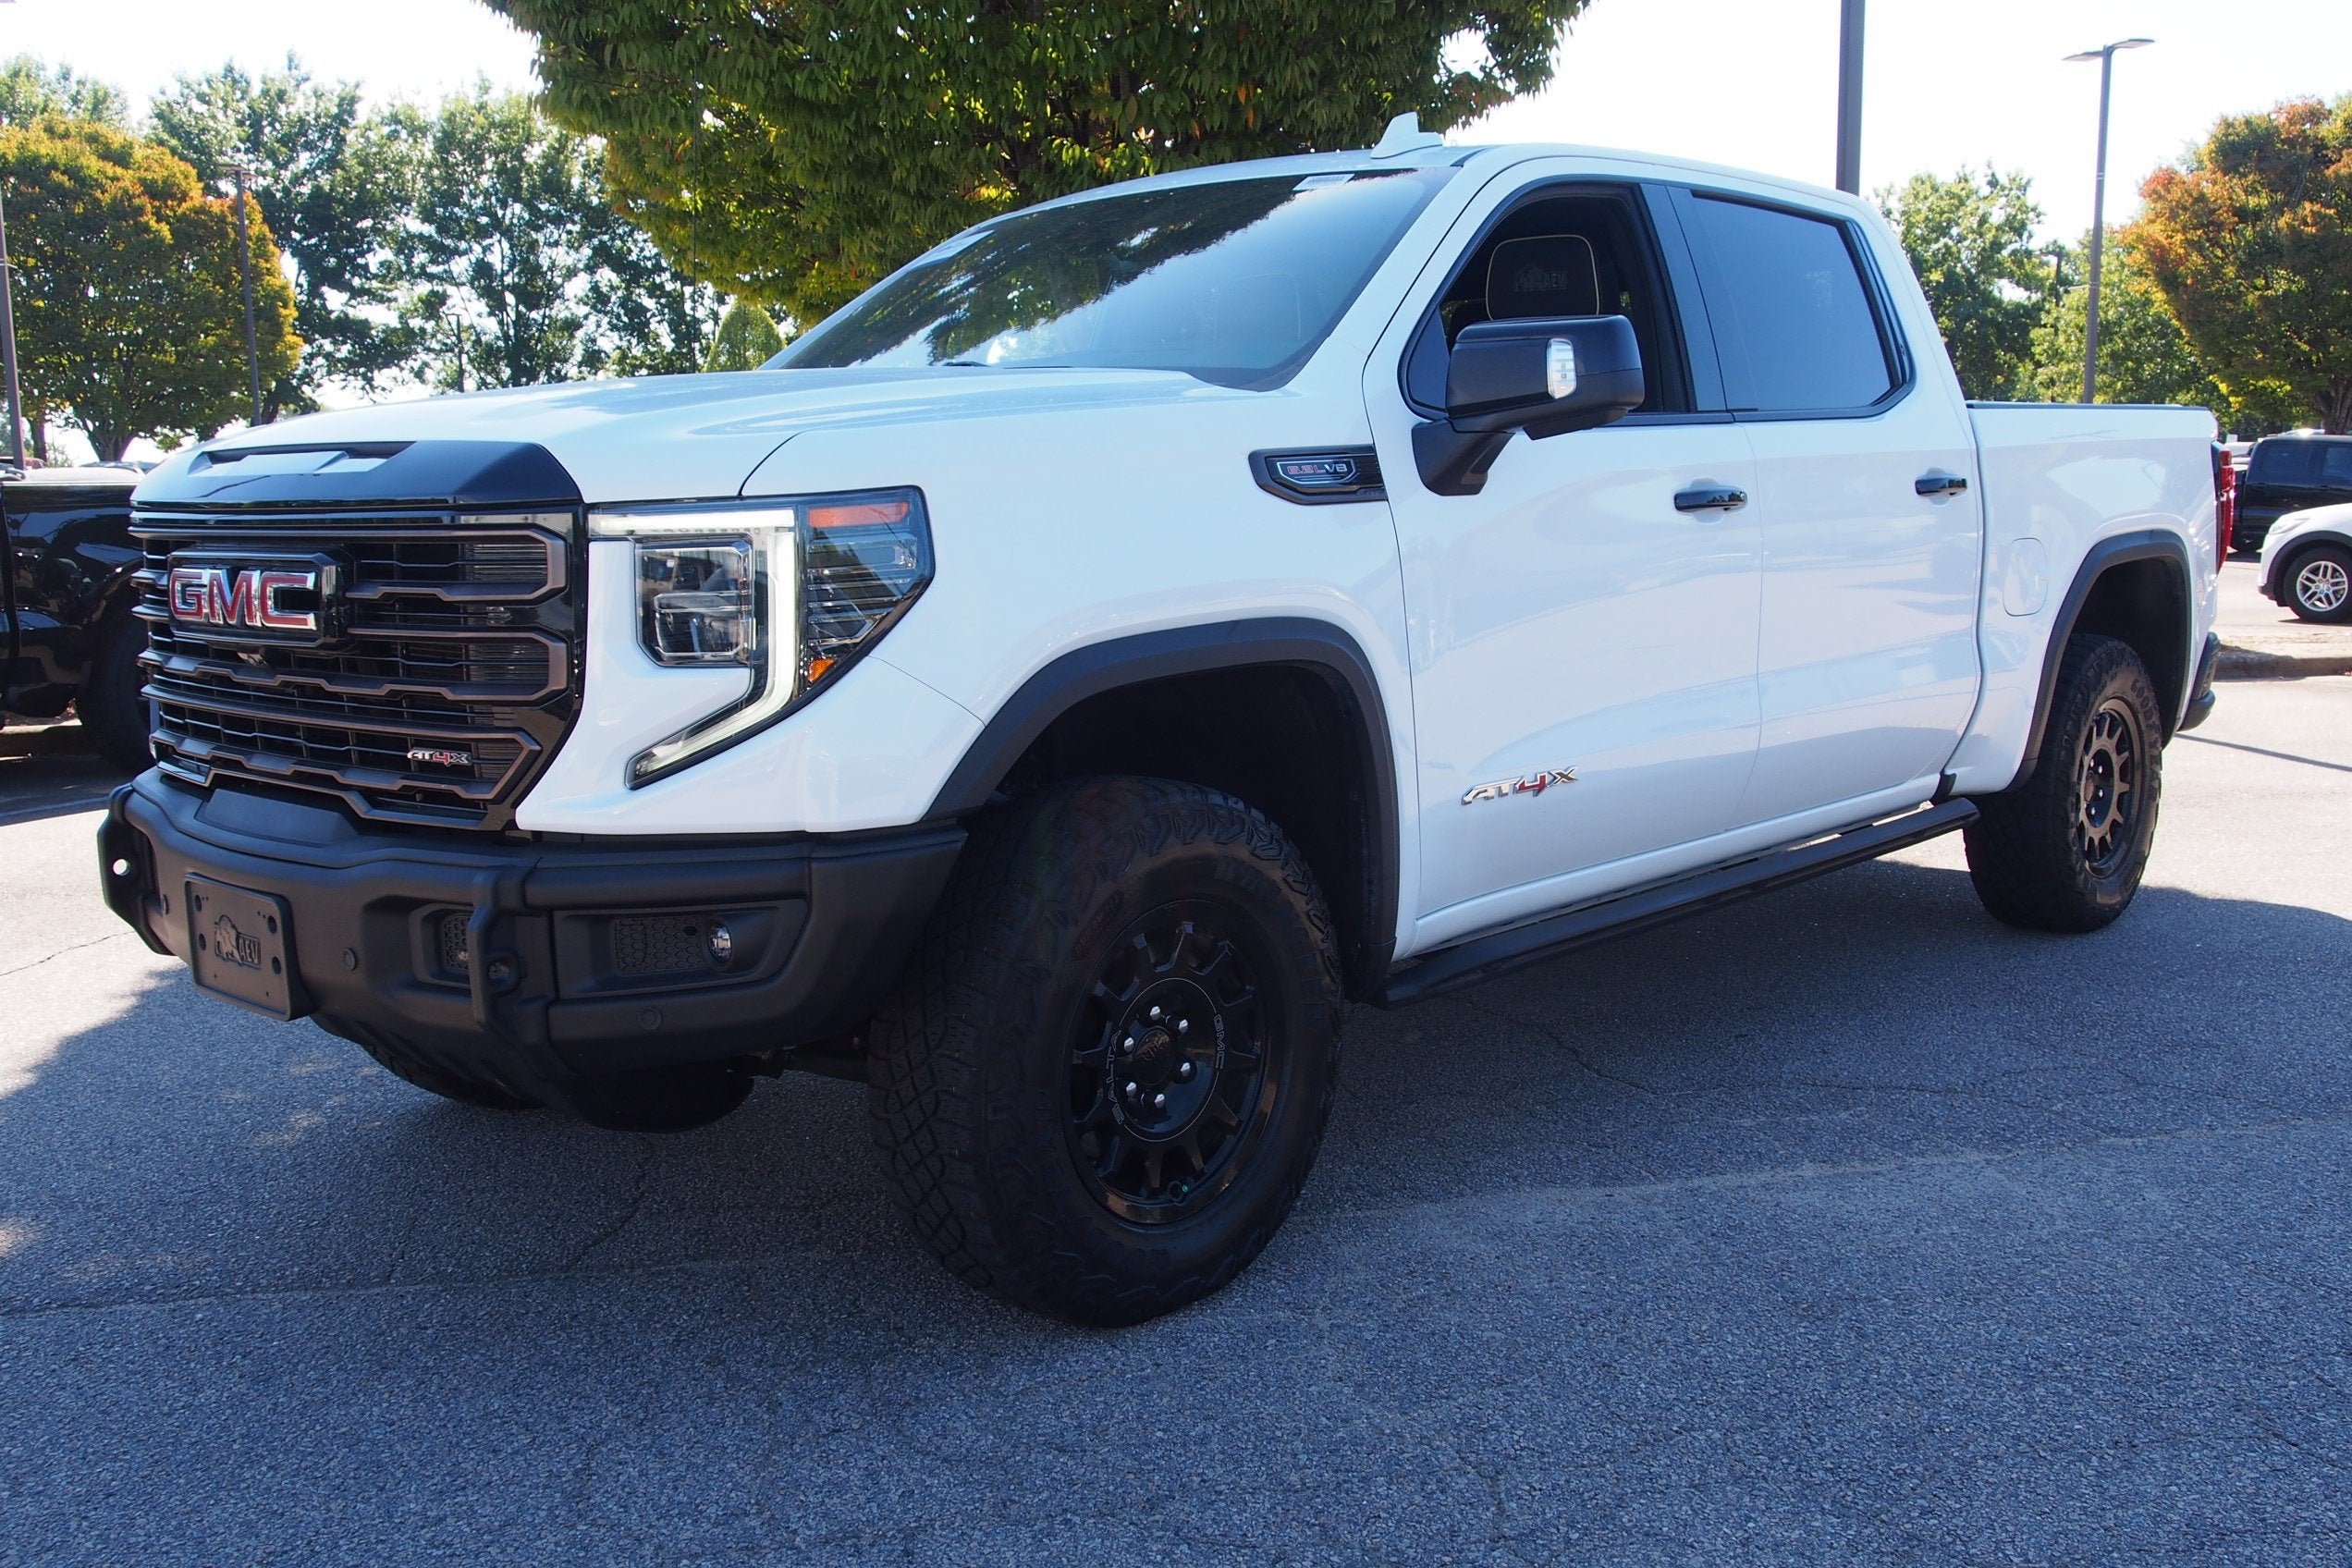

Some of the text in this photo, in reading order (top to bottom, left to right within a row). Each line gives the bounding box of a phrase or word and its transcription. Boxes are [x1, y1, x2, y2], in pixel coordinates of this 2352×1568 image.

[1325, 463, 1348, 472] V8
[169, 567, 317, 631] GMC
[407, 750, 470, 767] AT4X
[1461, 765, 1579, 806] AT4X
[239, 937, 261, 965] AEV
[1214, 1014, 1225, 1070] GMC
[1106, 1029, 1126, 1125] SALTA
